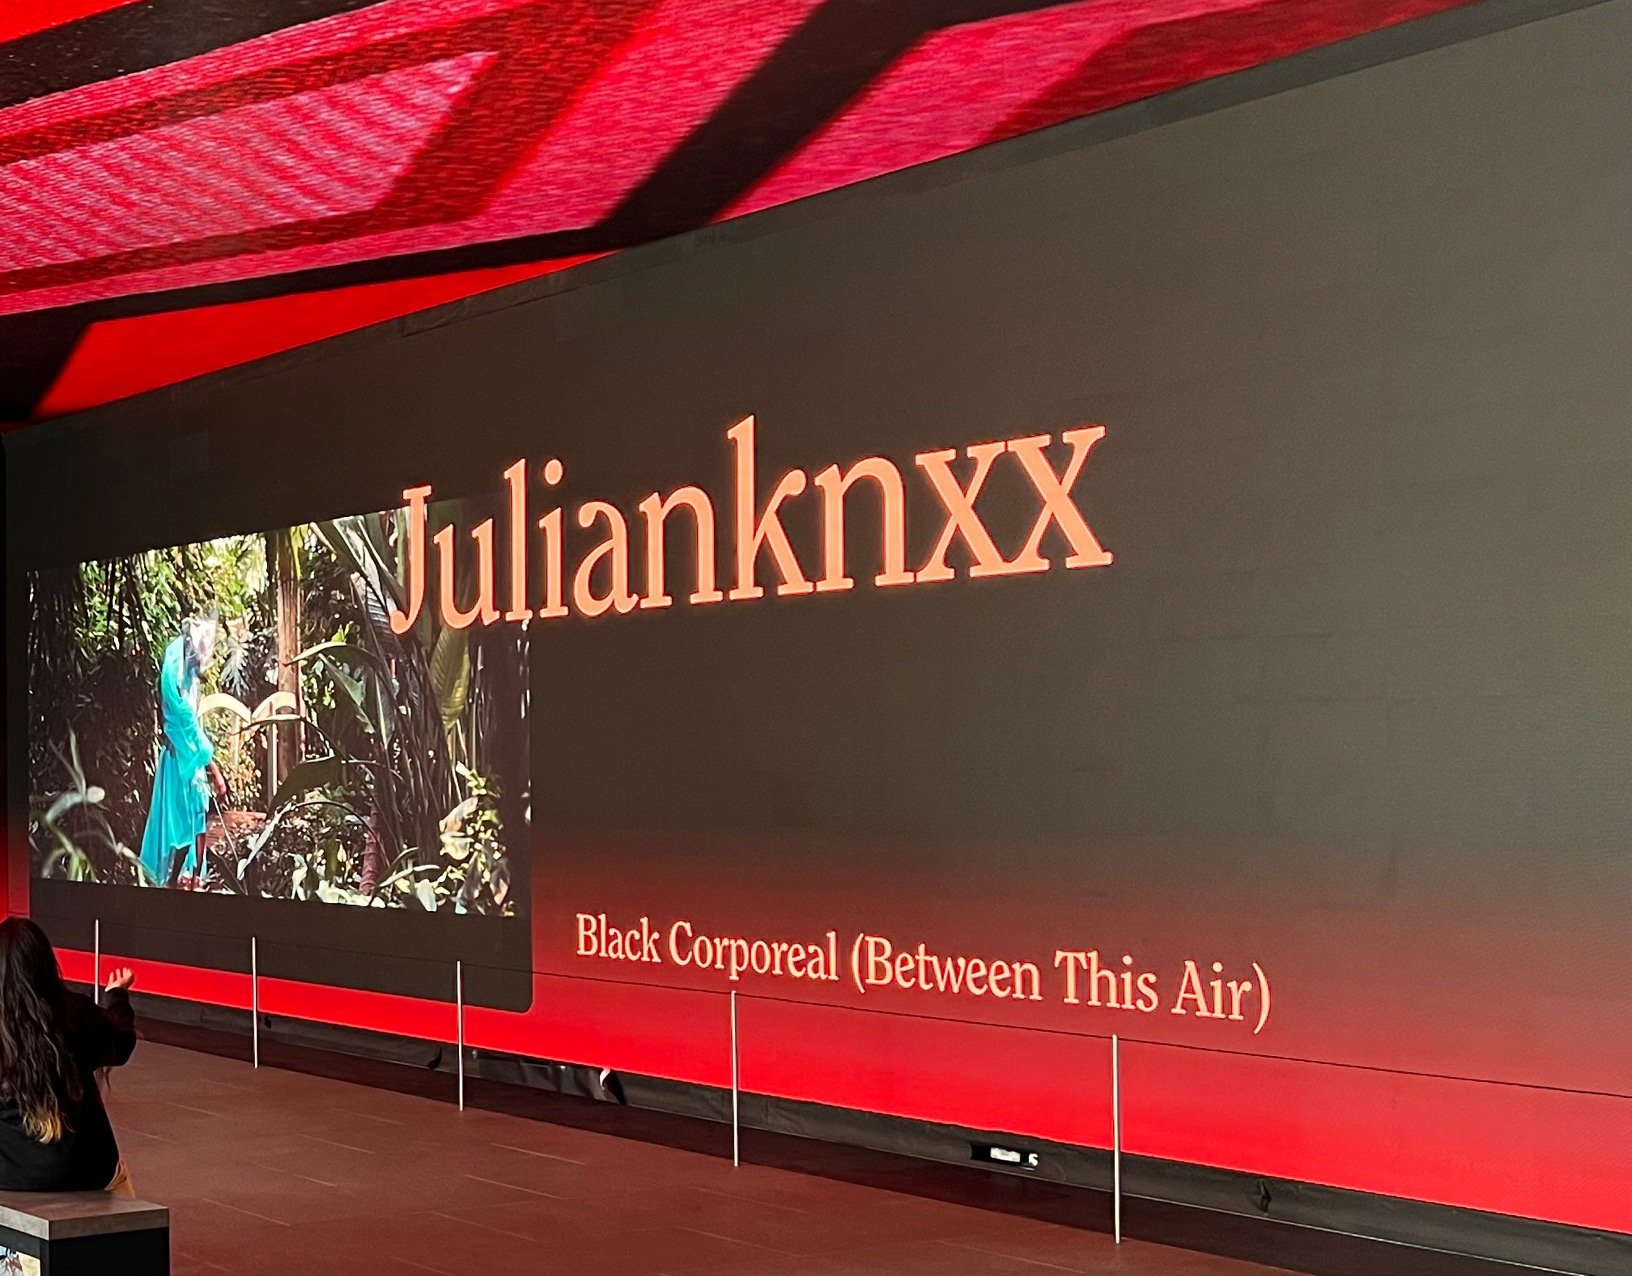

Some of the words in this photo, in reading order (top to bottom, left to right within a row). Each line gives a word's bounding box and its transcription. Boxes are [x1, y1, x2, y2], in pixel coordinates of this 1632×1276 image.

[389, 414, 1114, 635] Julianknxx
[575, 912, 662, 965] Black
[668, 920, 840, 981] Corporeal
[851, 932, 1043, 1001] (Between
[1054, 949, 1160, 1013] This
[1170, 959, 1271, 1035] Air)
